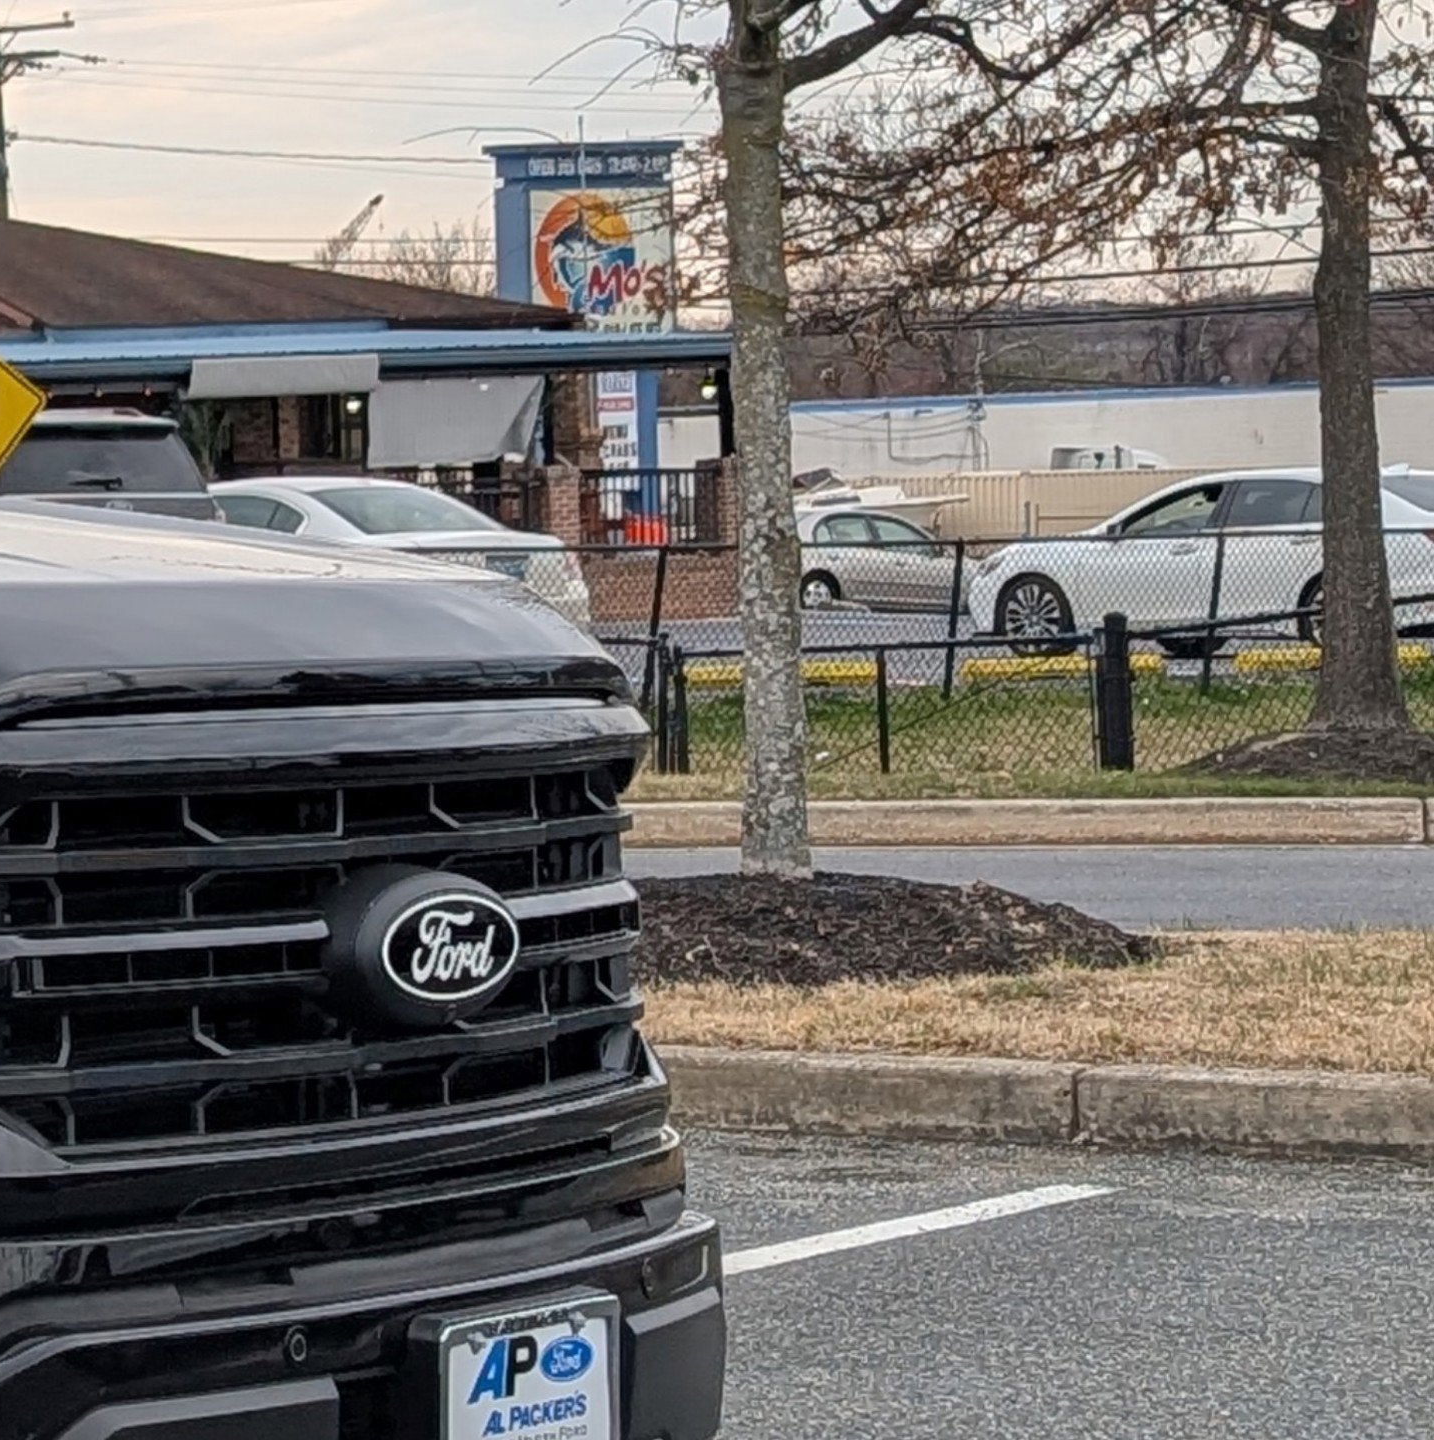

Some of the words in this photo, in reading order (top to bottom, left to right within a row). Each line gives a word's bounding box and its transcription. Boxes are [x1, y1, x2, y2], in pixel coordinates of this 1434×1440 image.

[410, 909, 496, 984] Ford
[467, 1335, 538, 1405] AP
[482, 1409, 506, 1436] AL
[508, 1390, 588, 1431] PACKER'S
